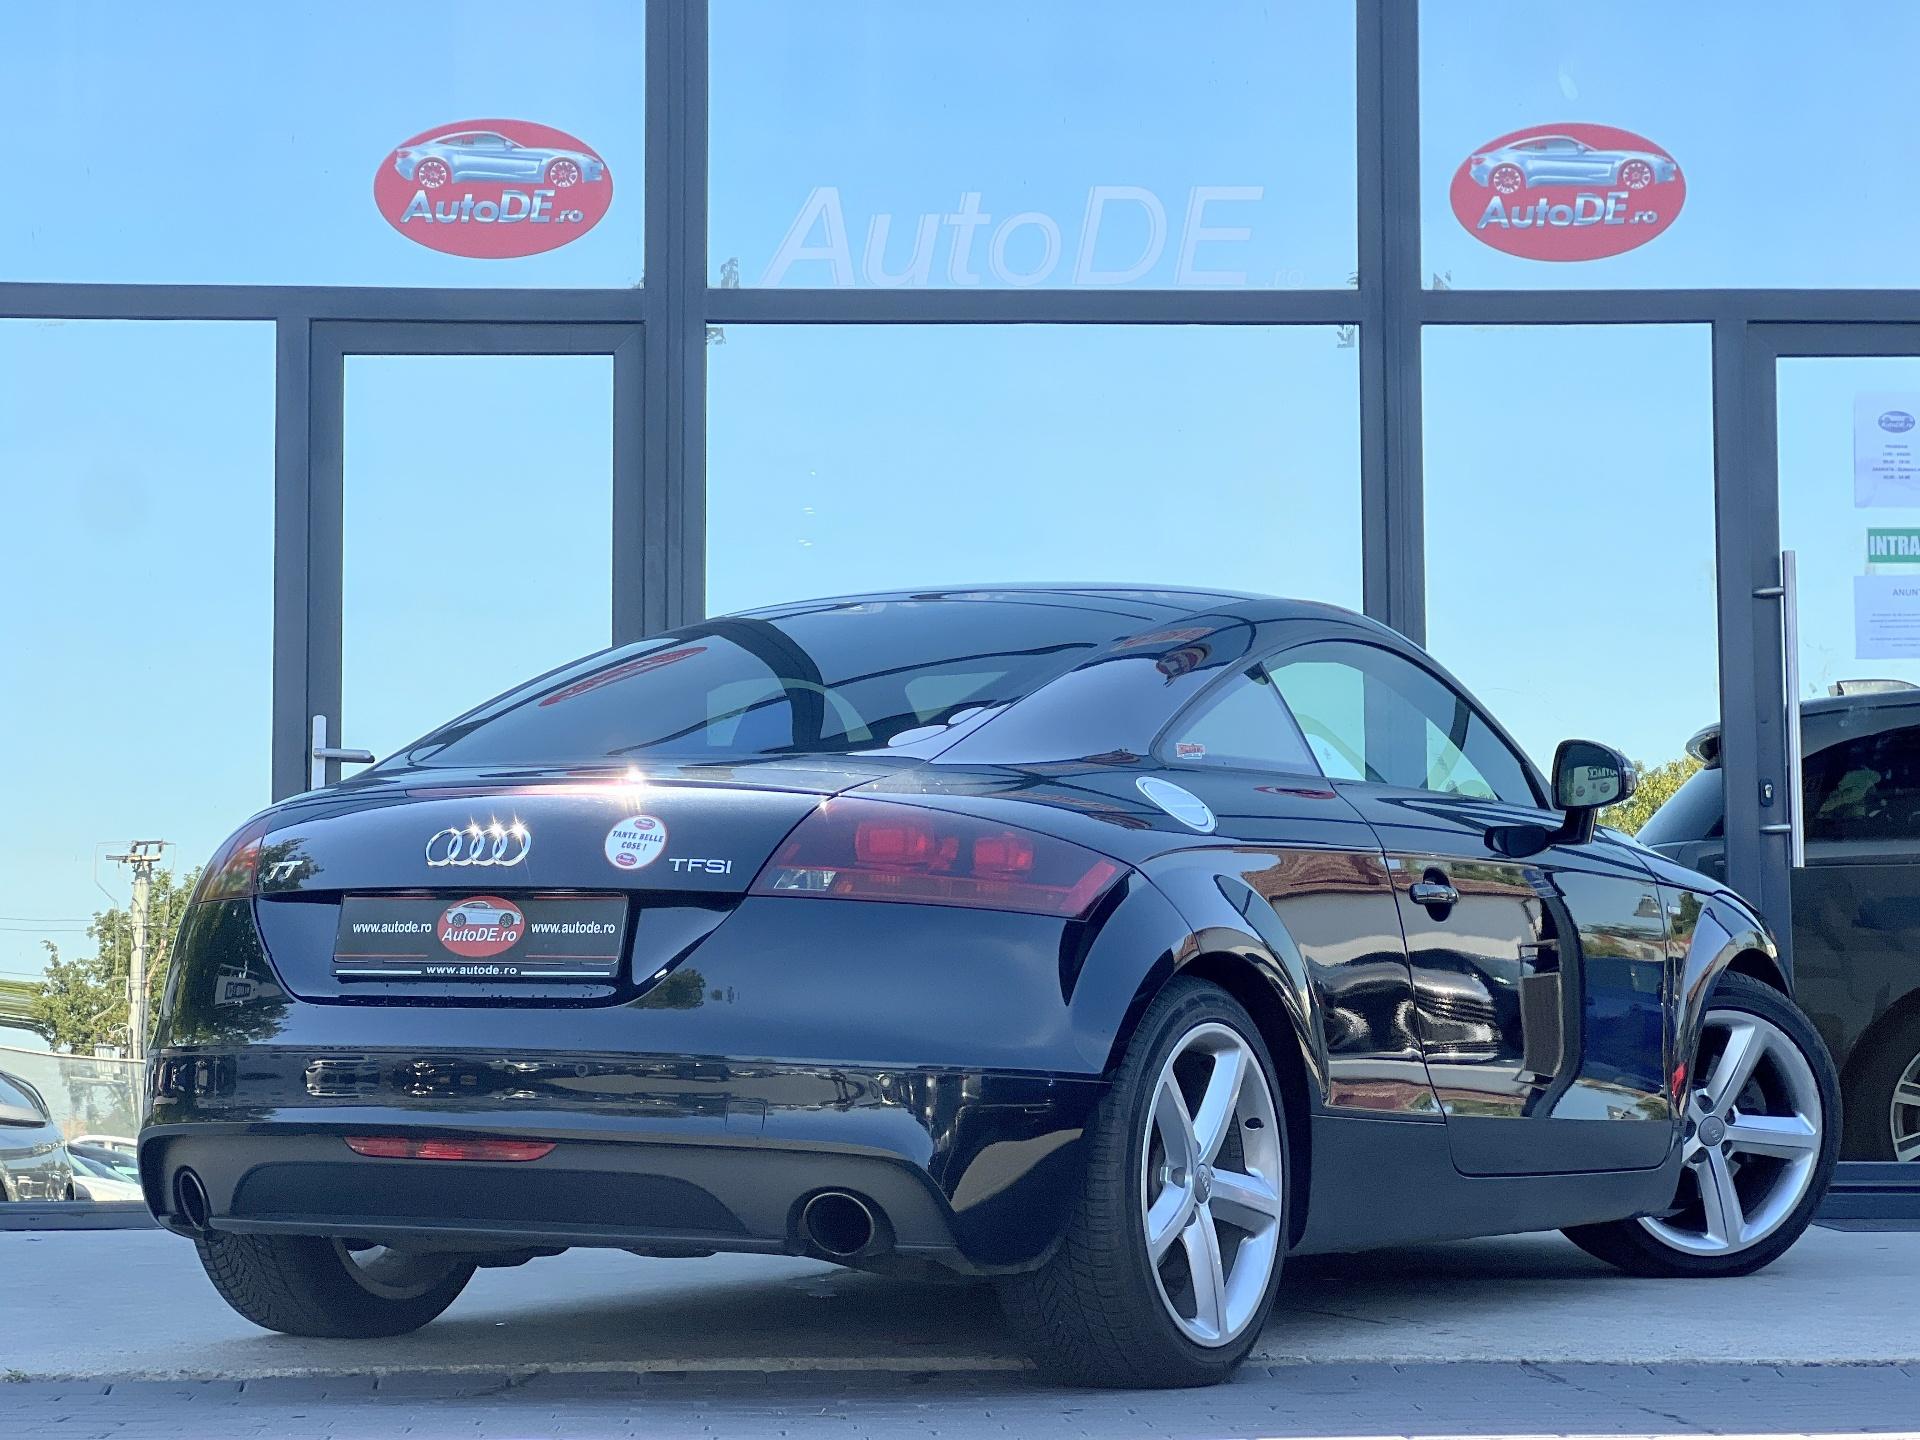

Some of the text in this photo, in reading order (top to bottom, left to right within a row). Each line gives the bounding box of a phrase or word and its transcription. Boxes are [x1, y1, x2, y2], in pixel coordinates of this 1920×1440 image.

[612, 831, 664, 842] TANTE BELLE
[267, 860, 304, 880] TT
[669, 859, 732, 873] TFSI
[353, 921, 432, 933] www.autode.ro
[531, 922, 616, 934] www.autode.ro
[441, 927, 517, 943] AutoDE.ro
[426, 965, 518, 975] www.autode.ro
